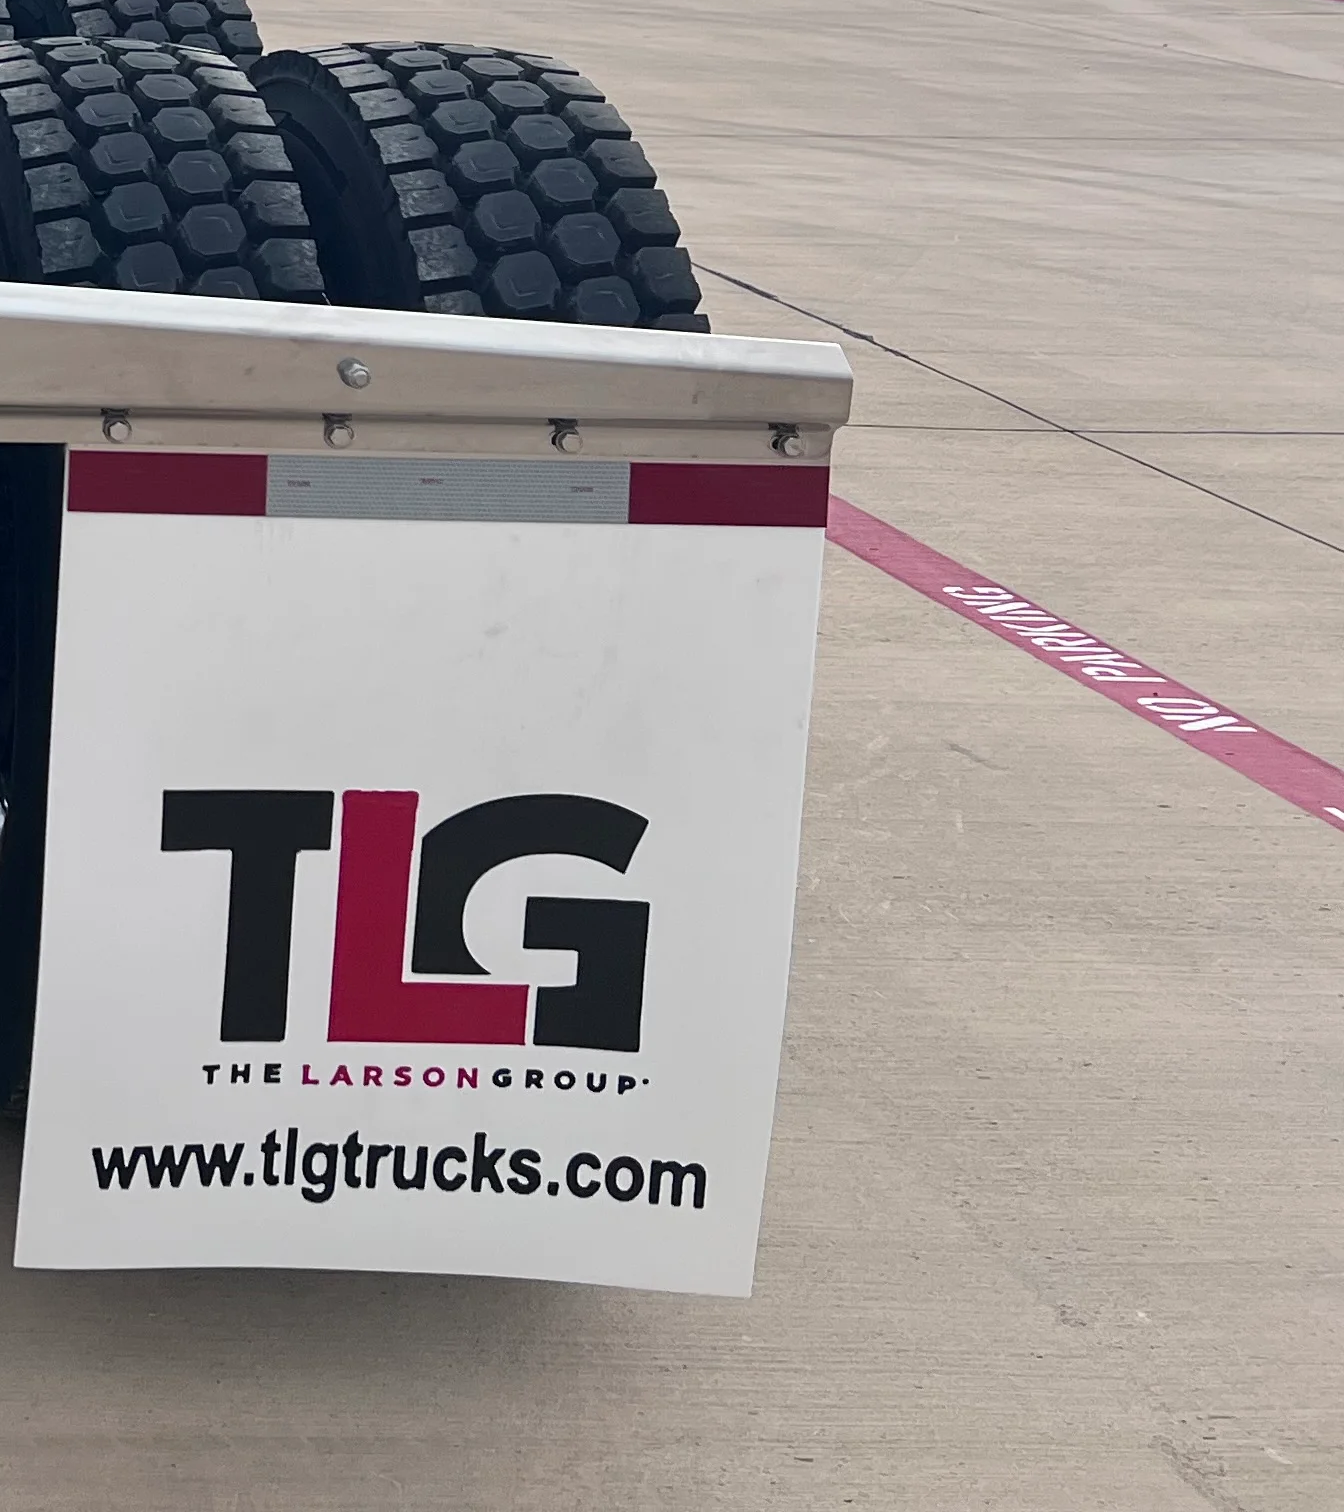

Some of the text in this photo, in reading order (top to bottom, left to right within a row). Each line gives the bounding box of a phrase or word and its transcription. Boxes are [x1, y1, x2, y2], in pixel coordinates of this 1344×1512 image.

[941, 584, 1258, 734] NO PARKING
[160, 789, 650, 1053] TLG
[202, 1064, 282, 1084] THE
[91, 1126, 708, 1210] www.tlgtrucks.com
